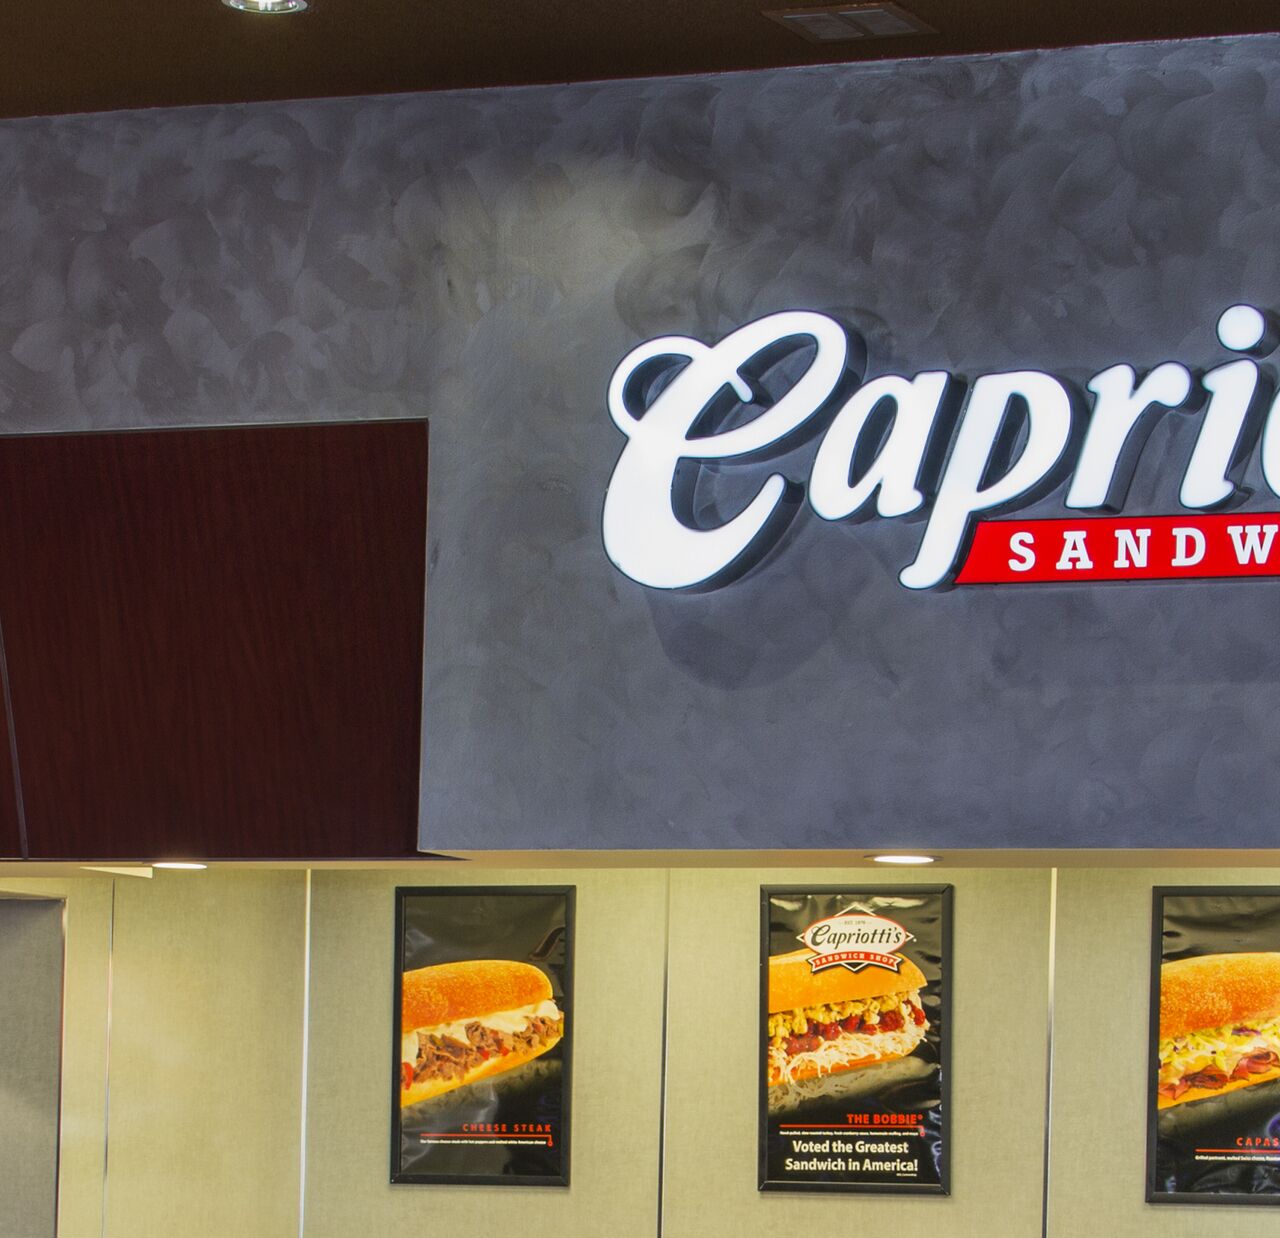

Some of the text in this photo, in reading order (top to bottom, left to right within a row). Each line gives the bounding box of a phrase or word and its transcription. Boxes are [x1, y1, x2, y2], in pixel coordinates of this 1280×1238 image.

[810, 924, 902, 950] Capriotti's
[815, 952, 896, 966] SANDWICH SHOP
[846, 1113, 870, 1125] THE
[462, 1123, 552, 1133] CHEESE STEAK
[792, 1140, 910, 1154] Voted the Greatest
[784, 1157, 919, 1173] Sandwich in America!
